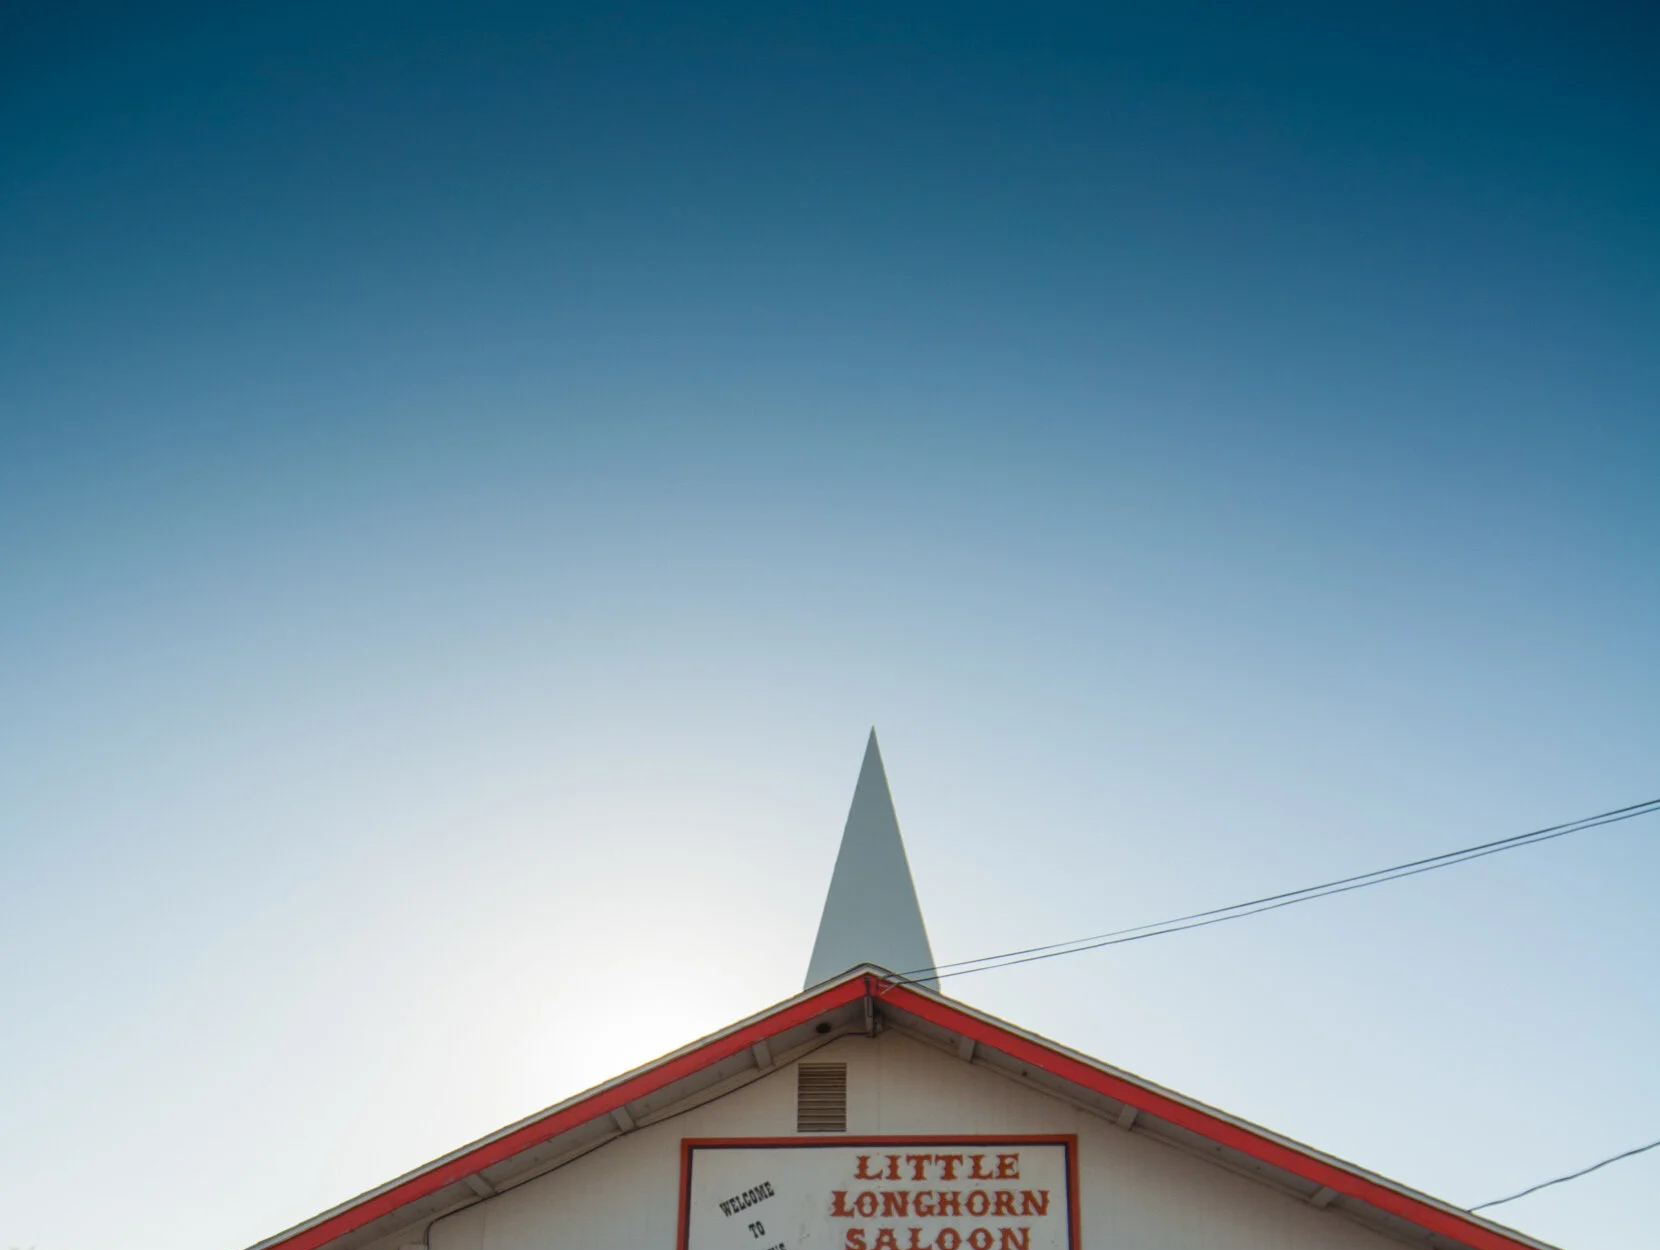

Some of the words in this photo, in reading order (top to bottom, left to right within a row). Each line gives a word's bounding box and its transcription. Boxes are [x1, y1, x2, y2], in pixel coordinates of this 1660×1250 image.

[854, 1153, 1021, 1180] LITTLE
[719, 1181, 776, 1217] WELCOME
[829, 1189, 1050, 1218] LONGHORN
[748, 1220, 766, 1240] TO
